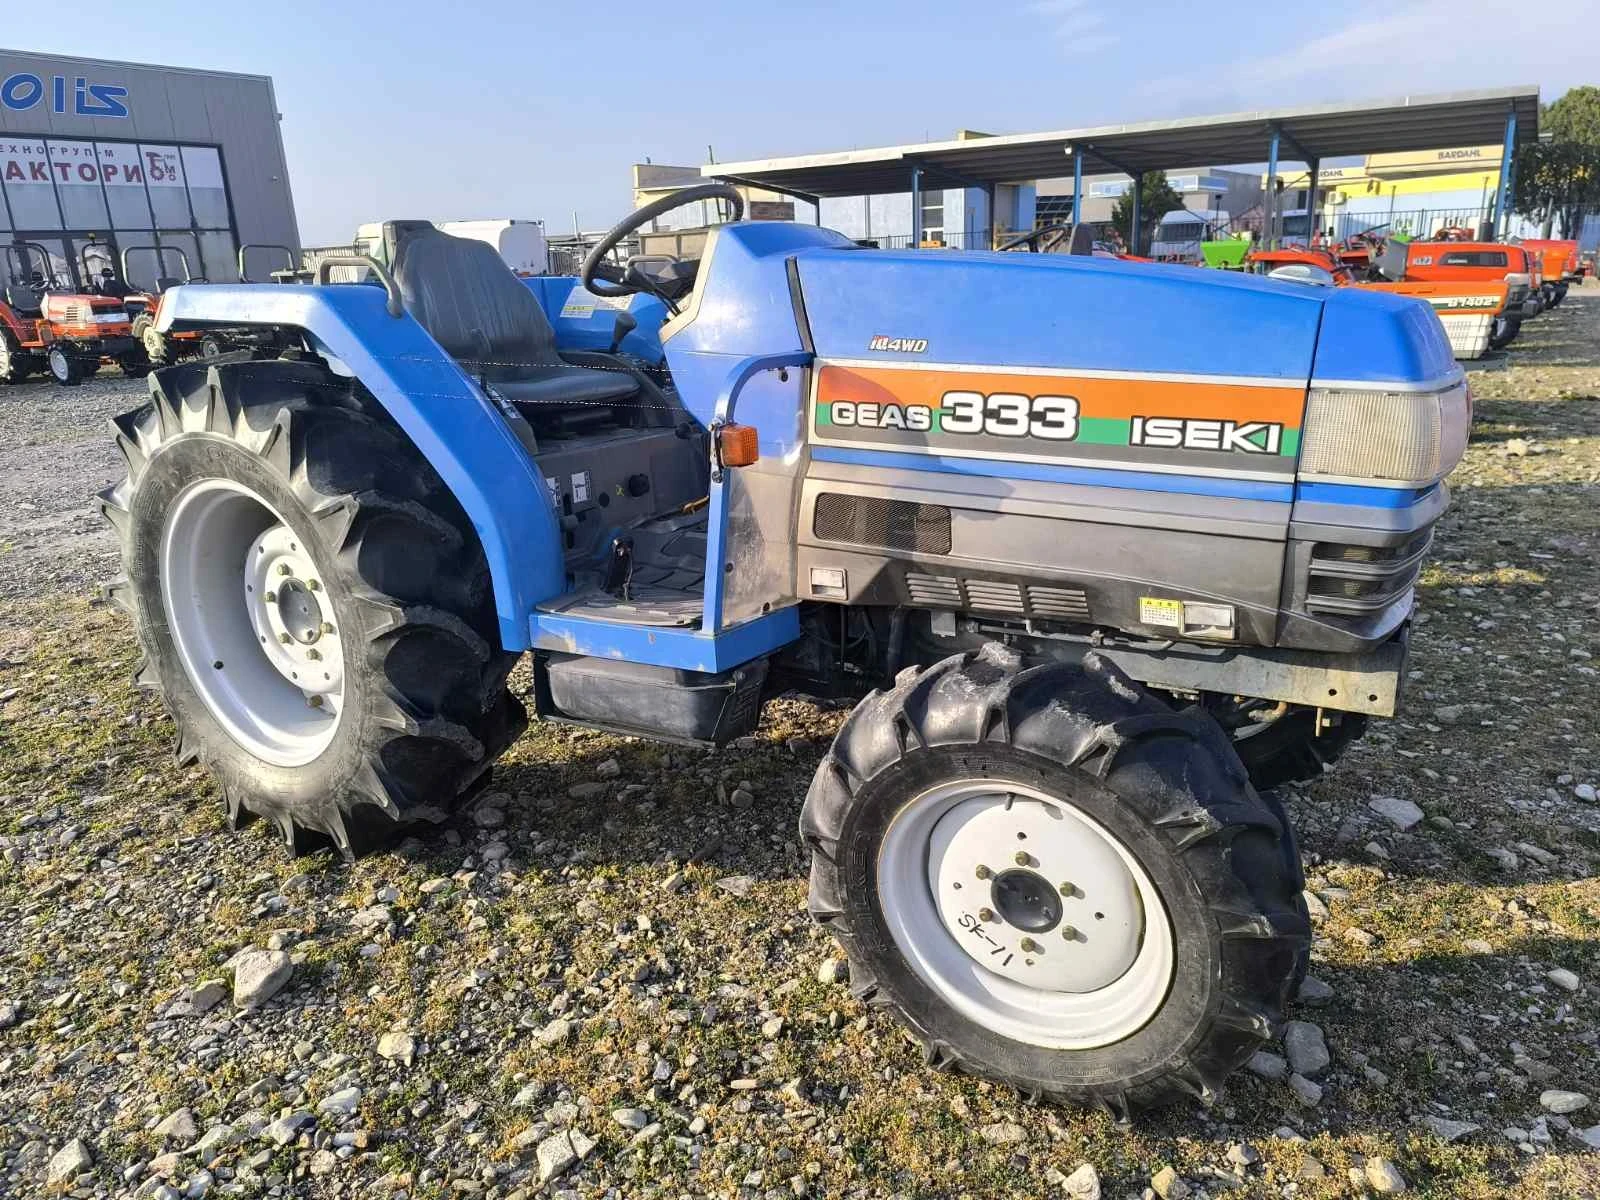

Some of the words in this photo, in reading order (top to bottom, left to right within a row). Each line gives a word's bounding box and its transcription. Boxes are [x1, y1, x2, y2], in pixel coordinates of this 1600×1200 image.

[5, 160, 142, 183] АКТОРИ
[1438, 150, 1481, 160] BARDAHL
[830, 402, 931, 431] GEAS
[940, 390, 1079, 441] 333
[1130, 416, 1282, 454] ISEKI
[957, 910, 1014, 967] SK-11
